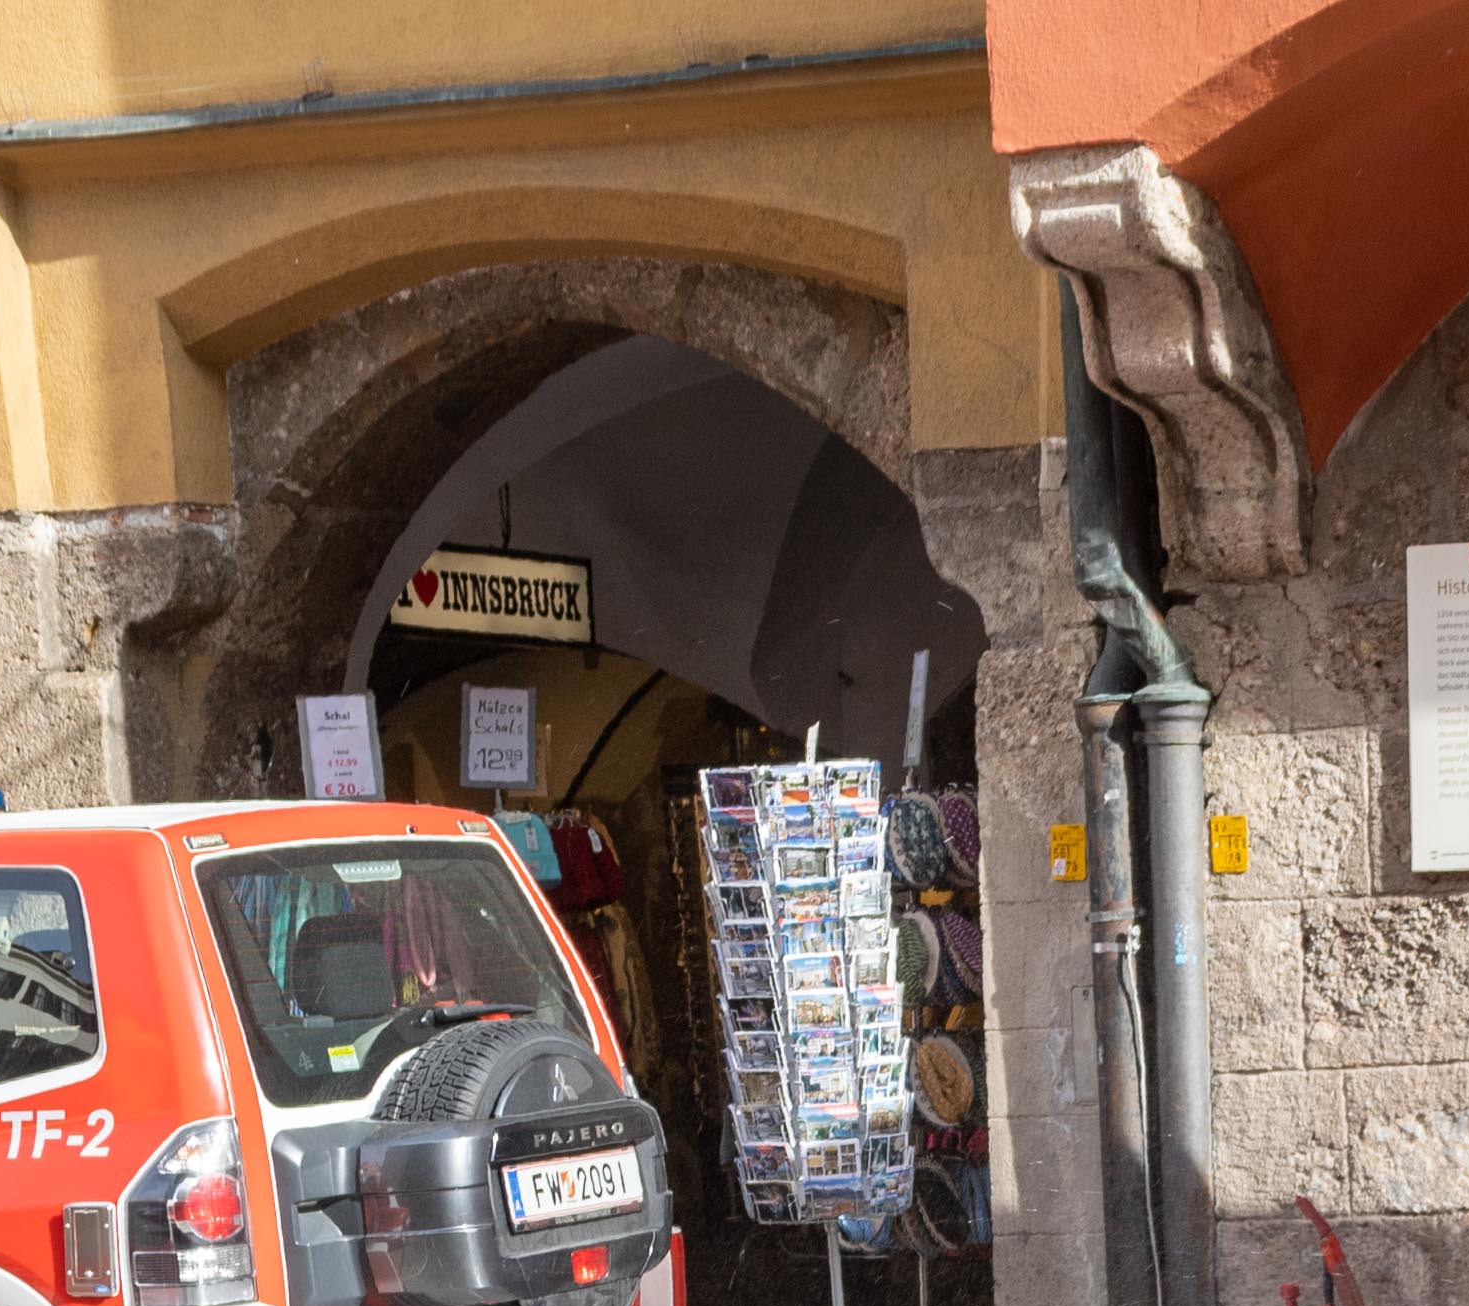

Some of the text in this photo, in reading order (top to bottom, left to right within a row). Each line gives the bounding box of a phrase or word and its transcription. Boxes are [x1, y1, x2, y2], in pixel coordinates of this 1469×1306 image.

[440, 570, 581, 622] INNSBRUCK
[324, 783, 333, 796] €
[0, 1108, 115, 1160] TF-2
[533, 1121, 625, 1148] PAJERO
[532, 1161, 627, 1209] FW 2091
